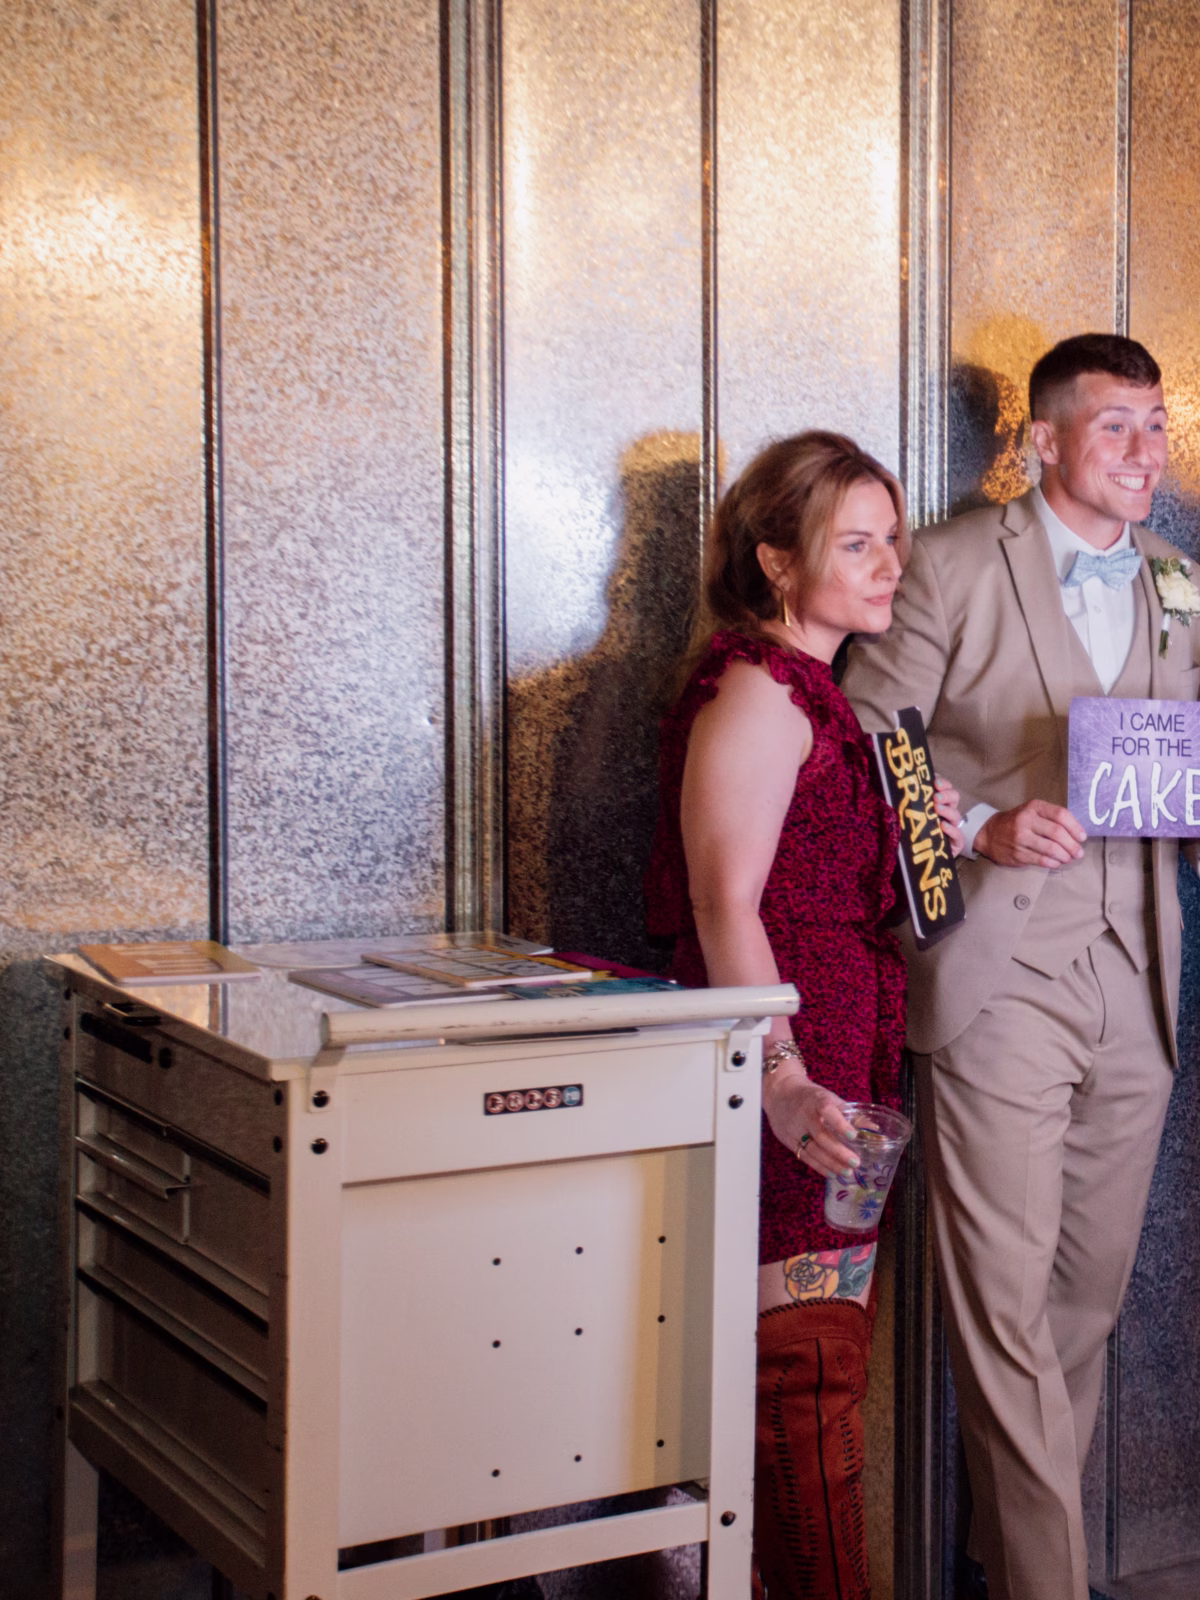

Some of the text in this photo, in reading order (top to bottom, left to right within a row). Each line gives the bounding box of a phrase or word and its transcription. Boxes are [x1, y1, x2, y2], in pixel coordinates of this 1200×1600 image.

[1111, 736, 1193, 758] FOR THE
[1119, 711, 1186, 733] I CAME
[885, 727, 947, 922] BRAINS
[912, 746, 953, 888] BEAUTY &
